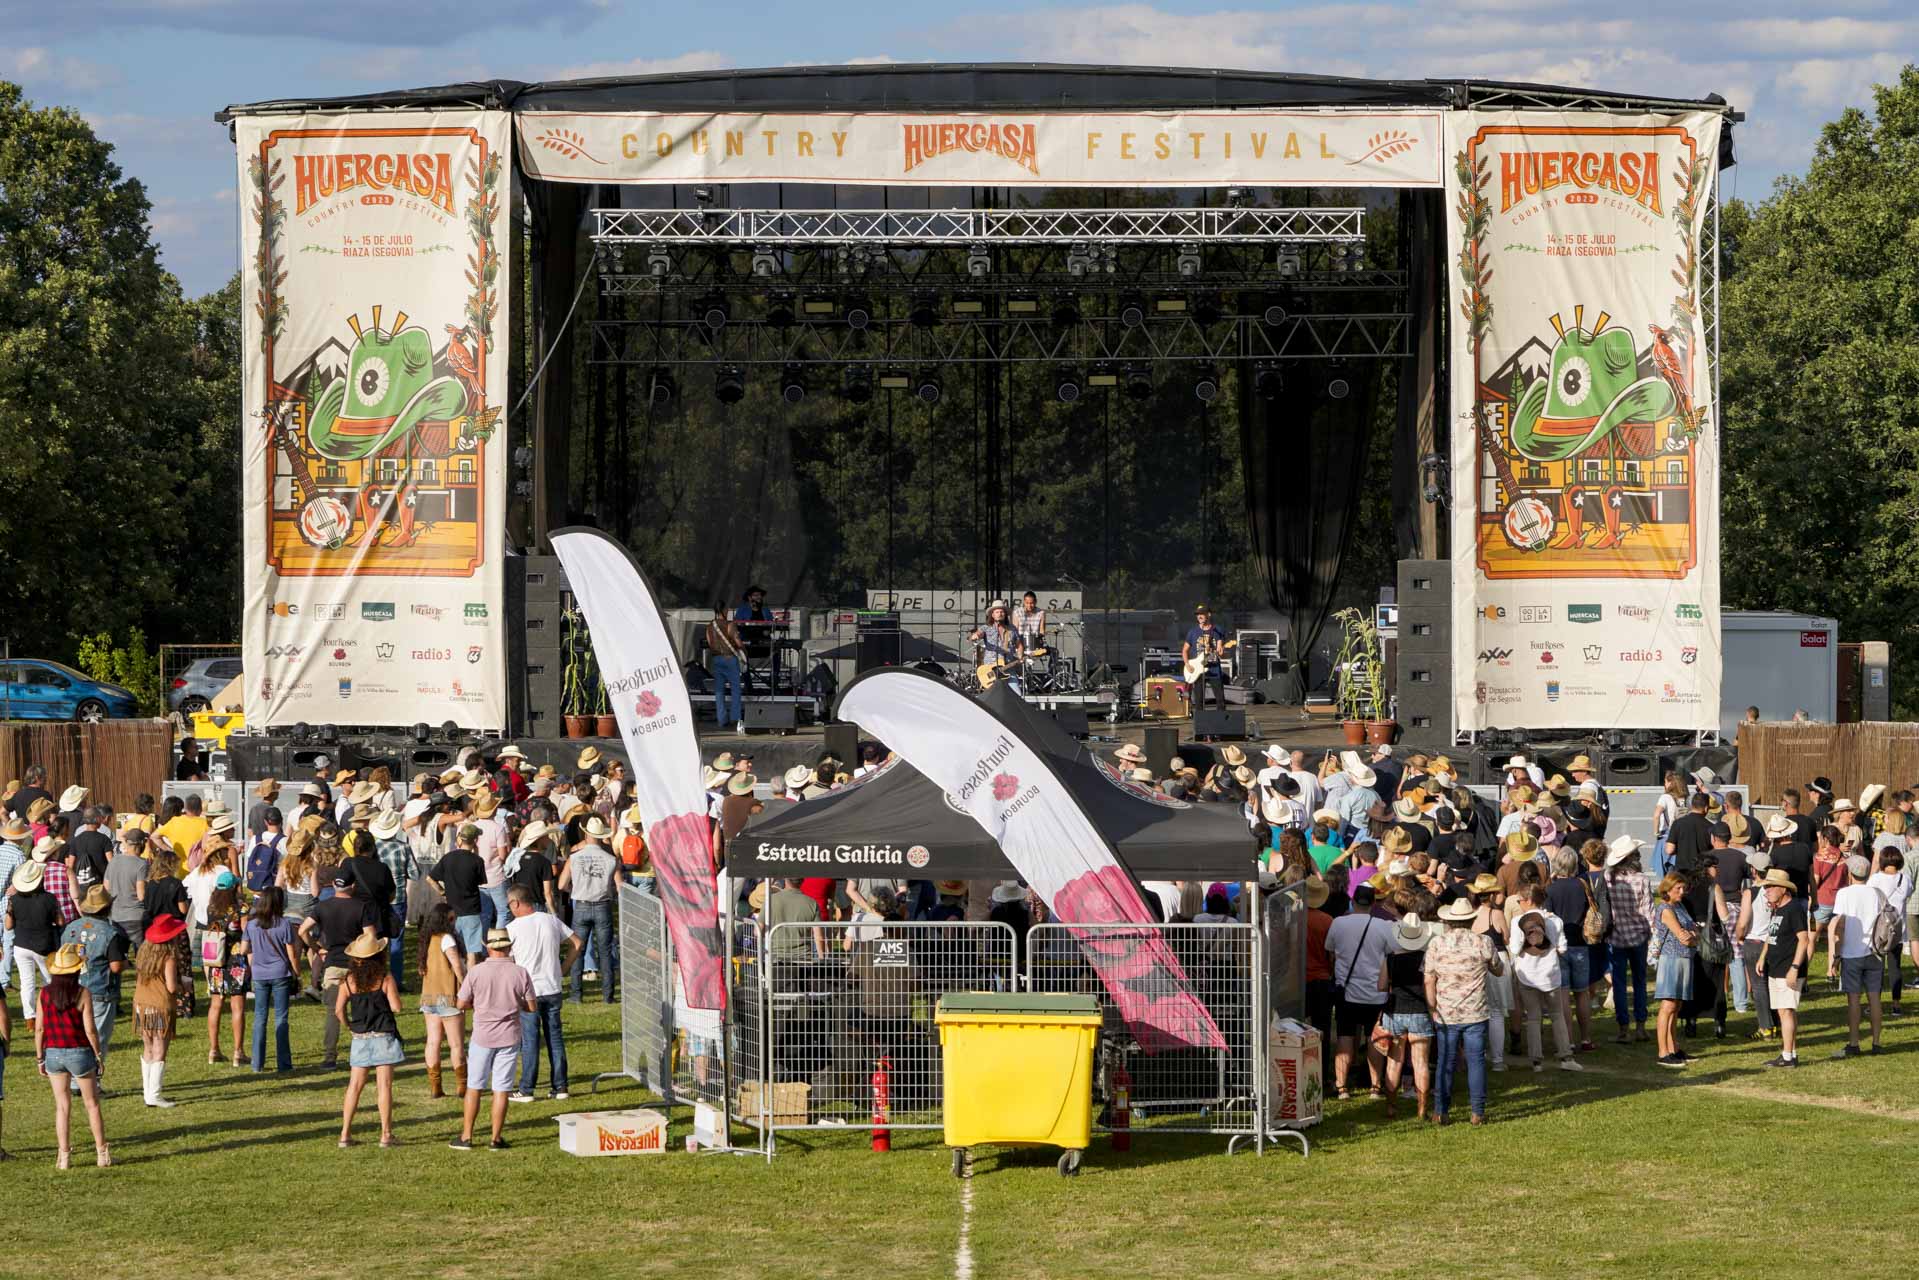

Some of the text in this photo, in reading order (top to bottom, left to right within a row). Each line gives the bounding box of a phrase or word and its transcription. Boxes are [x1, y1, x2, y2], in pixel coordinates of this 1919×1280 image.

[621, 123, 1335, 177] COUNTRY HUERCASA FESTIVAL
[294, 153, 457, 217] HUERCASA
[1499, 152, 1665, 218] HUERCASA
[308, 199, 356, 228] COUNTRY
[1511, 198, 1559, 226] COUNTRY
[1602, 197, 1656, 227] FESTIVAL
[343, 236, 352, 245] 14
[362, 236, 371, 245] 15
[374, 236, 385, 245] DE
[387, 236, 412, 245] JULIO
[1546, 235, 1556, 244] 14
[1564, 235, 1574, 244] 15
[1577, 235, 1588, 244] DE
[1590, 235, 1616, 244] JULIO
[343, 246, 414, 257] RIAZA (SEGOVIA)
[1546, 246, 1617, 257] RIAZA (SEGOVIA)
[412, 648, 452, 660] radio 3
[1620, 650, 1662, 661] radio 3
[756, 842, 903, 865] Estrella Galicia
[880, 942, 903, 954] AMS
[598, 1124, 660, 1152] HUERCASA
